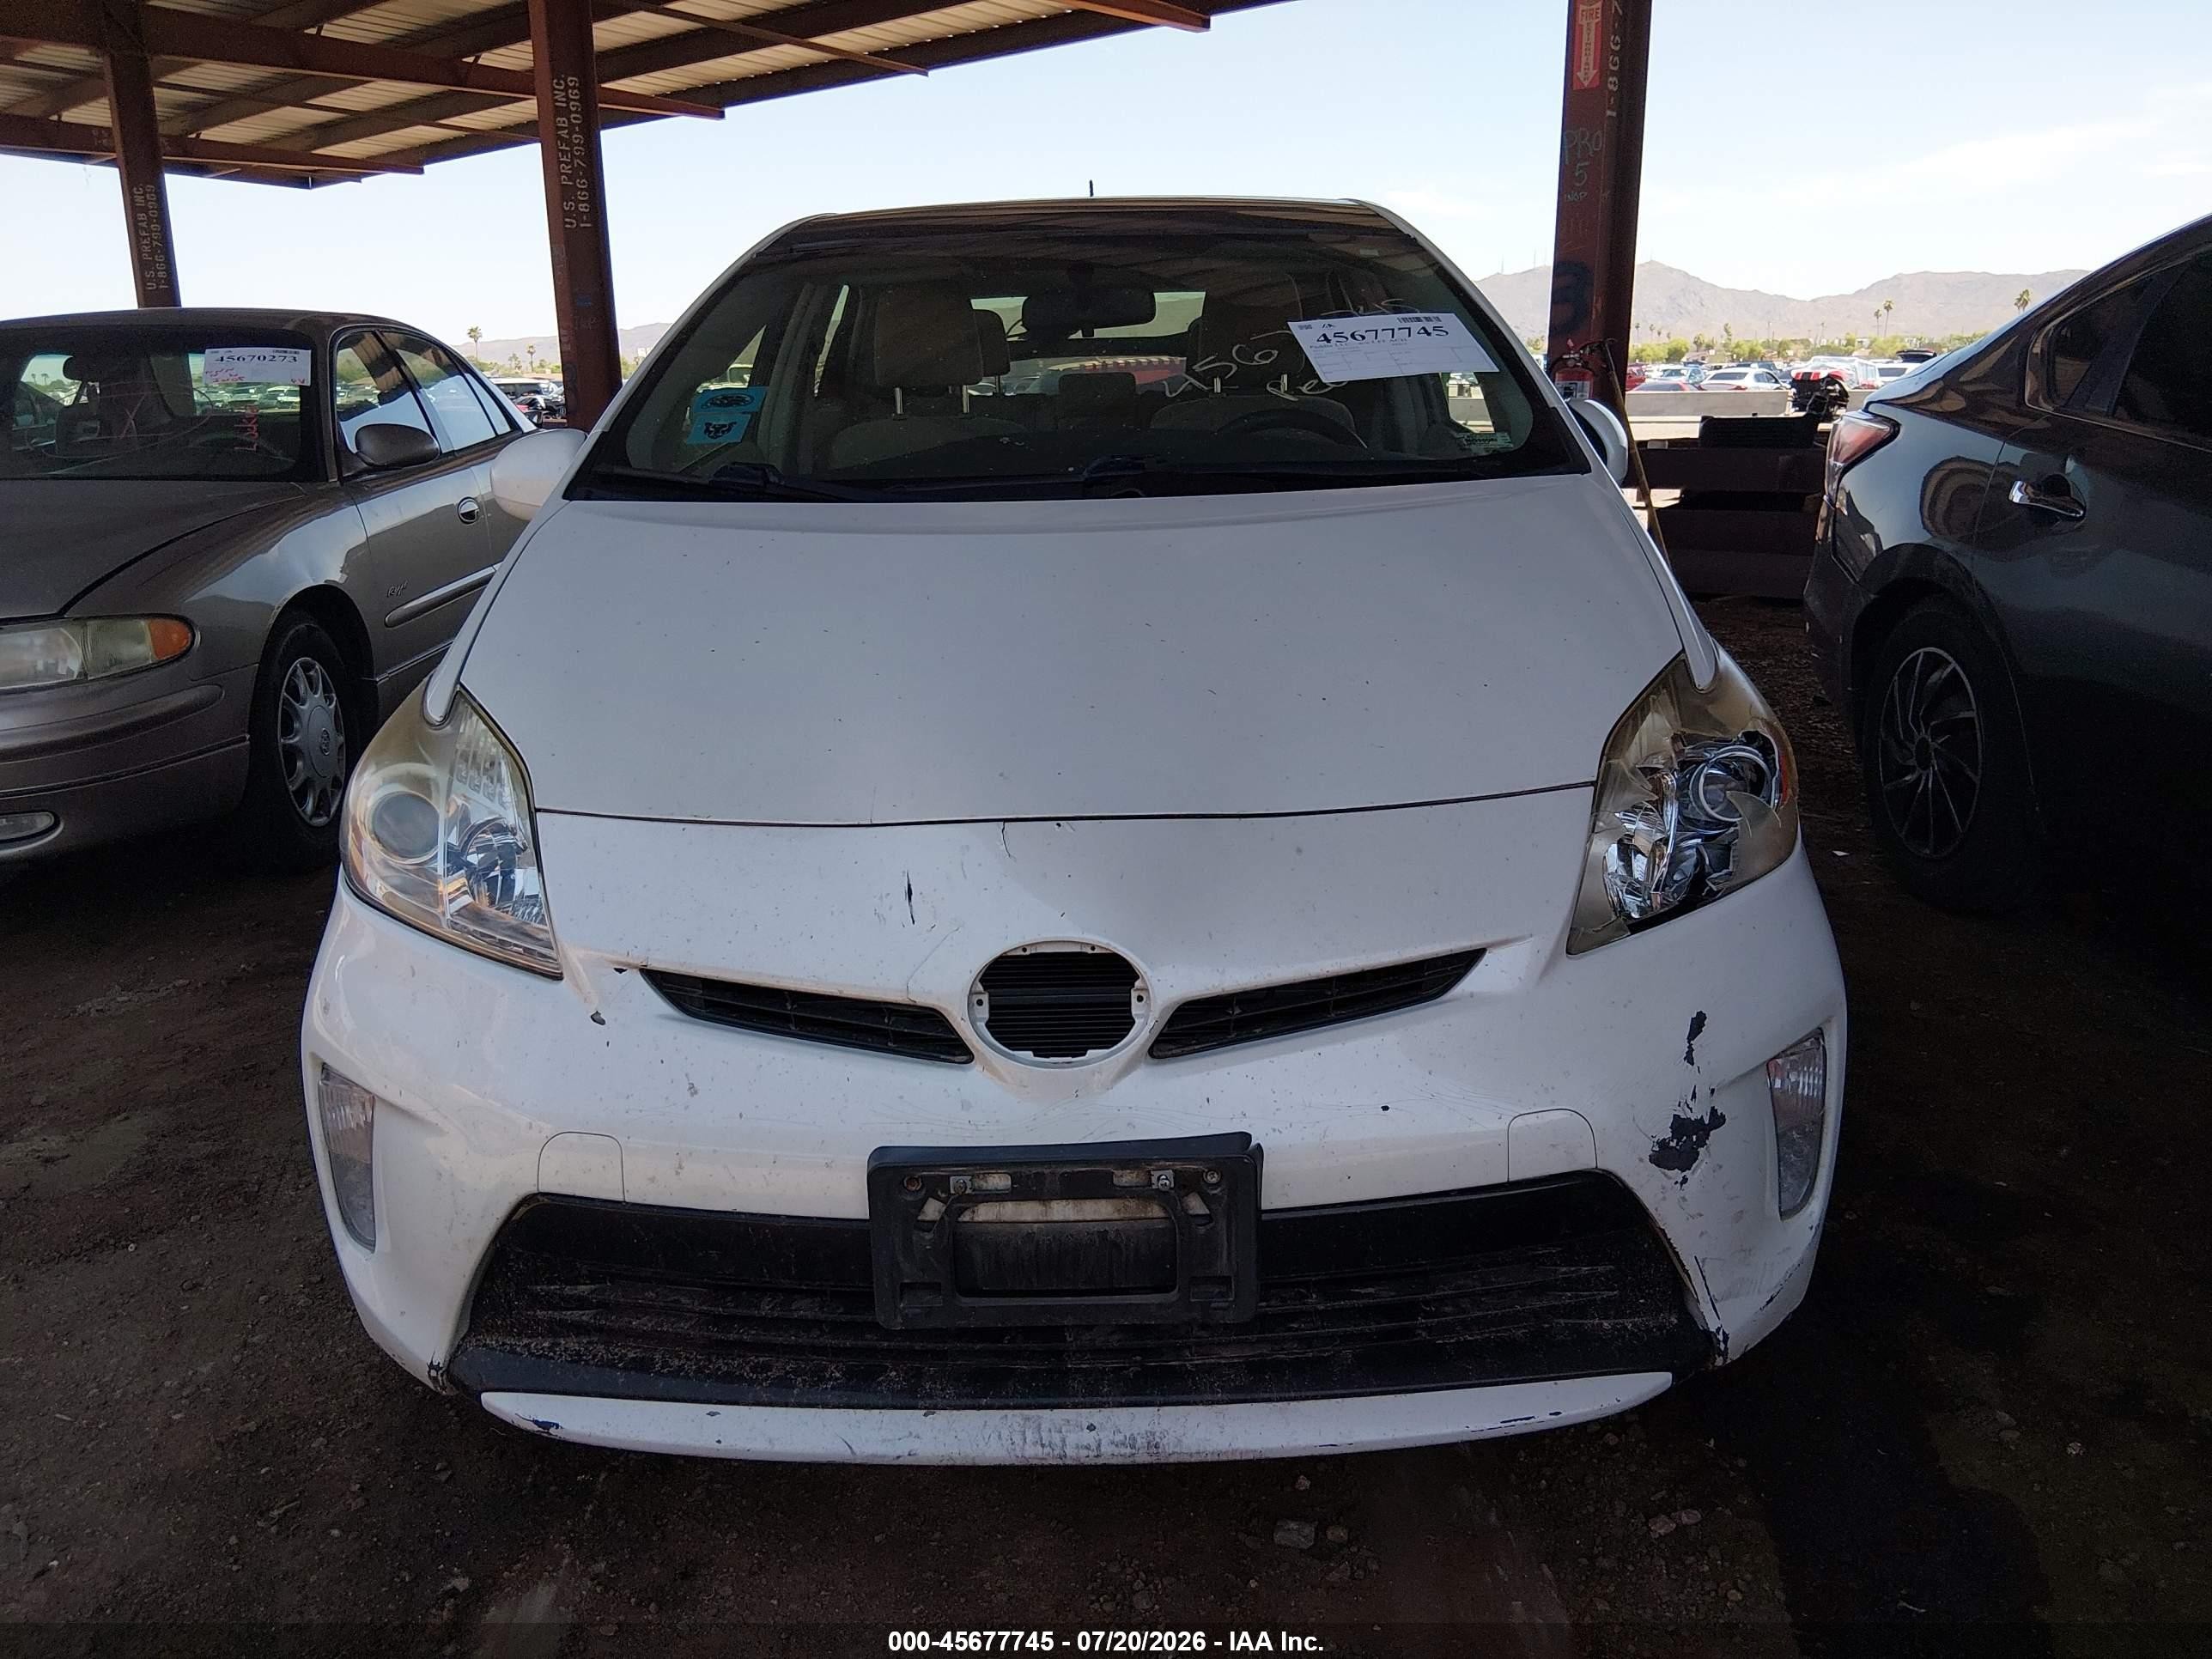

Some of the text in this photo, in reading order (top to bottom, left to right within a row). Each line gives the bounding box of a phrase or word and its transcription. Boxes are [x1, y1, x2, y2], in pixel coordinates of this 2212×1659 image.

[1581, 7, 1601, 21] FIRE
[553, 74, 577, 229] U.S. PREFAB INC.
[567, 76, 592, 228] 1-866-799-0969
[137, 212, 153, 261] PREFAB
[145, 266, 157, 290] U.S.
[1316, 325, 1449, 344] 45677745
[215, 355, 298, 363] 45670273
